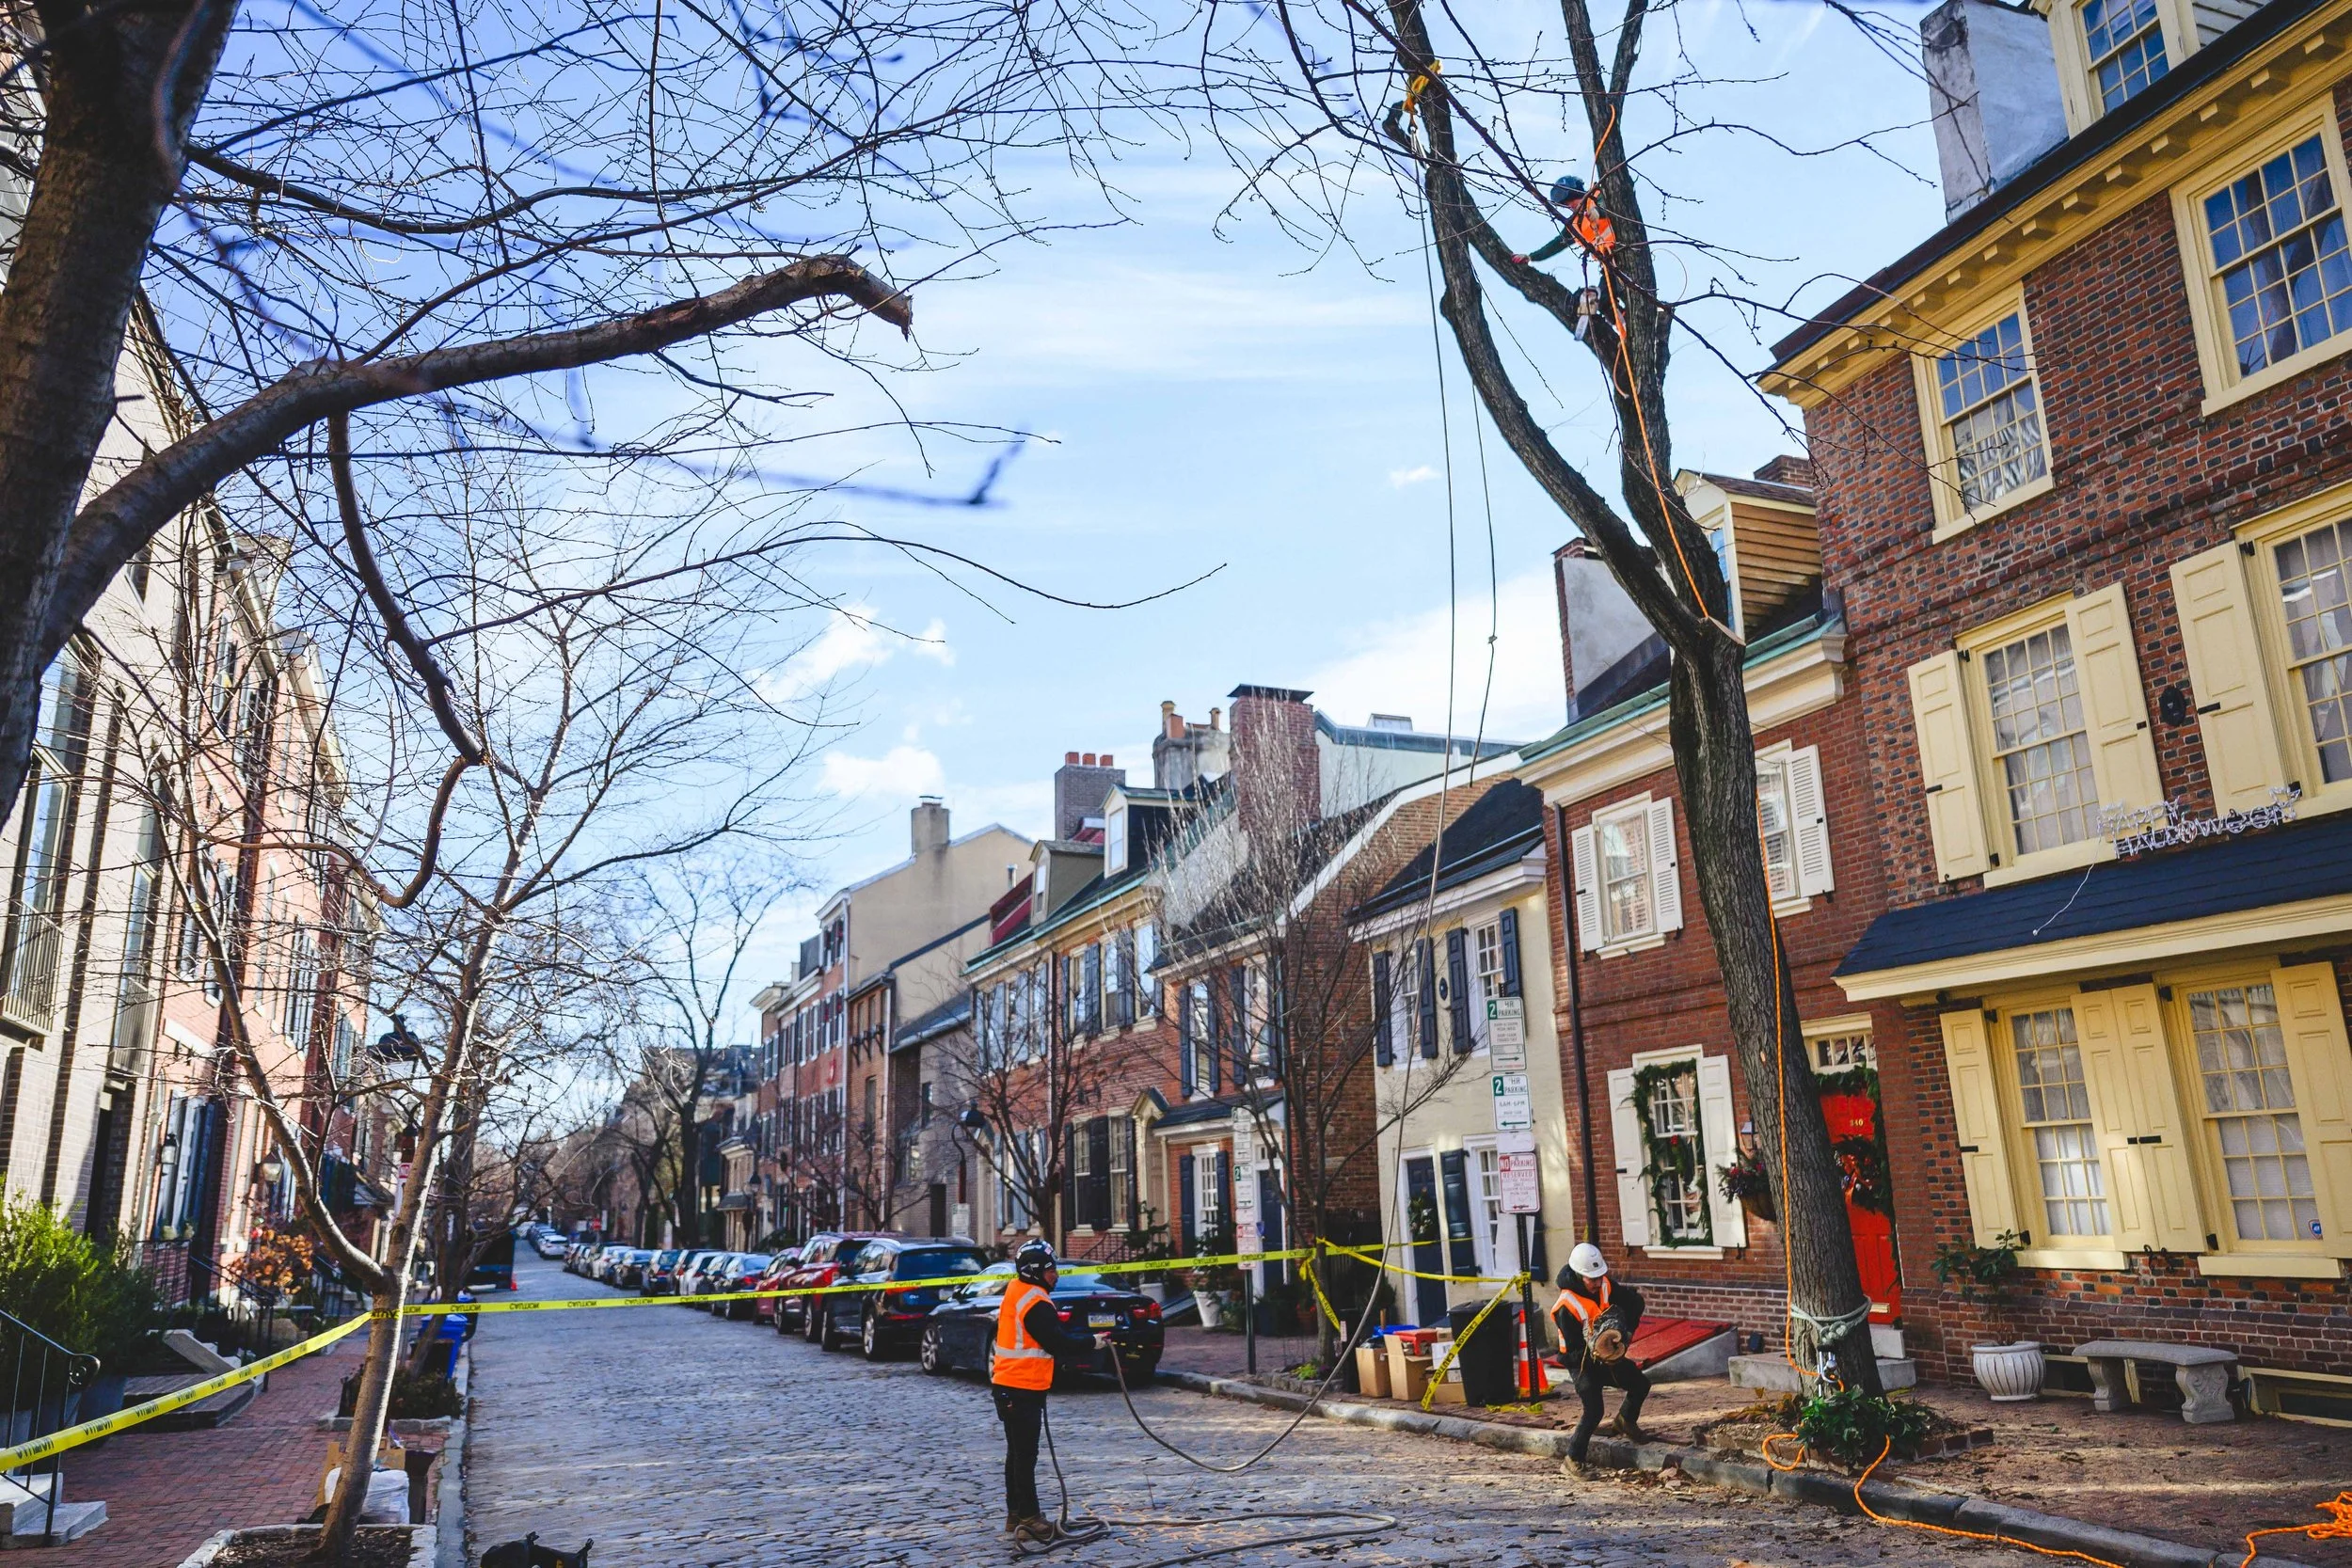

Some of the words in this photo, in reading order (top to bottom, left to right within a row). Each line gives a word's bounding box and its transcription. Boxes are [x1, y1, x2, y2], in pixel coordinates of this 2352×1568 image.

[1488, 1003, 1497, 1019] 2
[1499, 1008, 1521, 1017] PARKING
[1495, 1079, 1502, 1094] 2
[1500, 1159, 1510, 1171] NO
[1455, 1321, 1478, 1348] CAUTION
[1433, 1353, 1454, 1384] CAUTION
